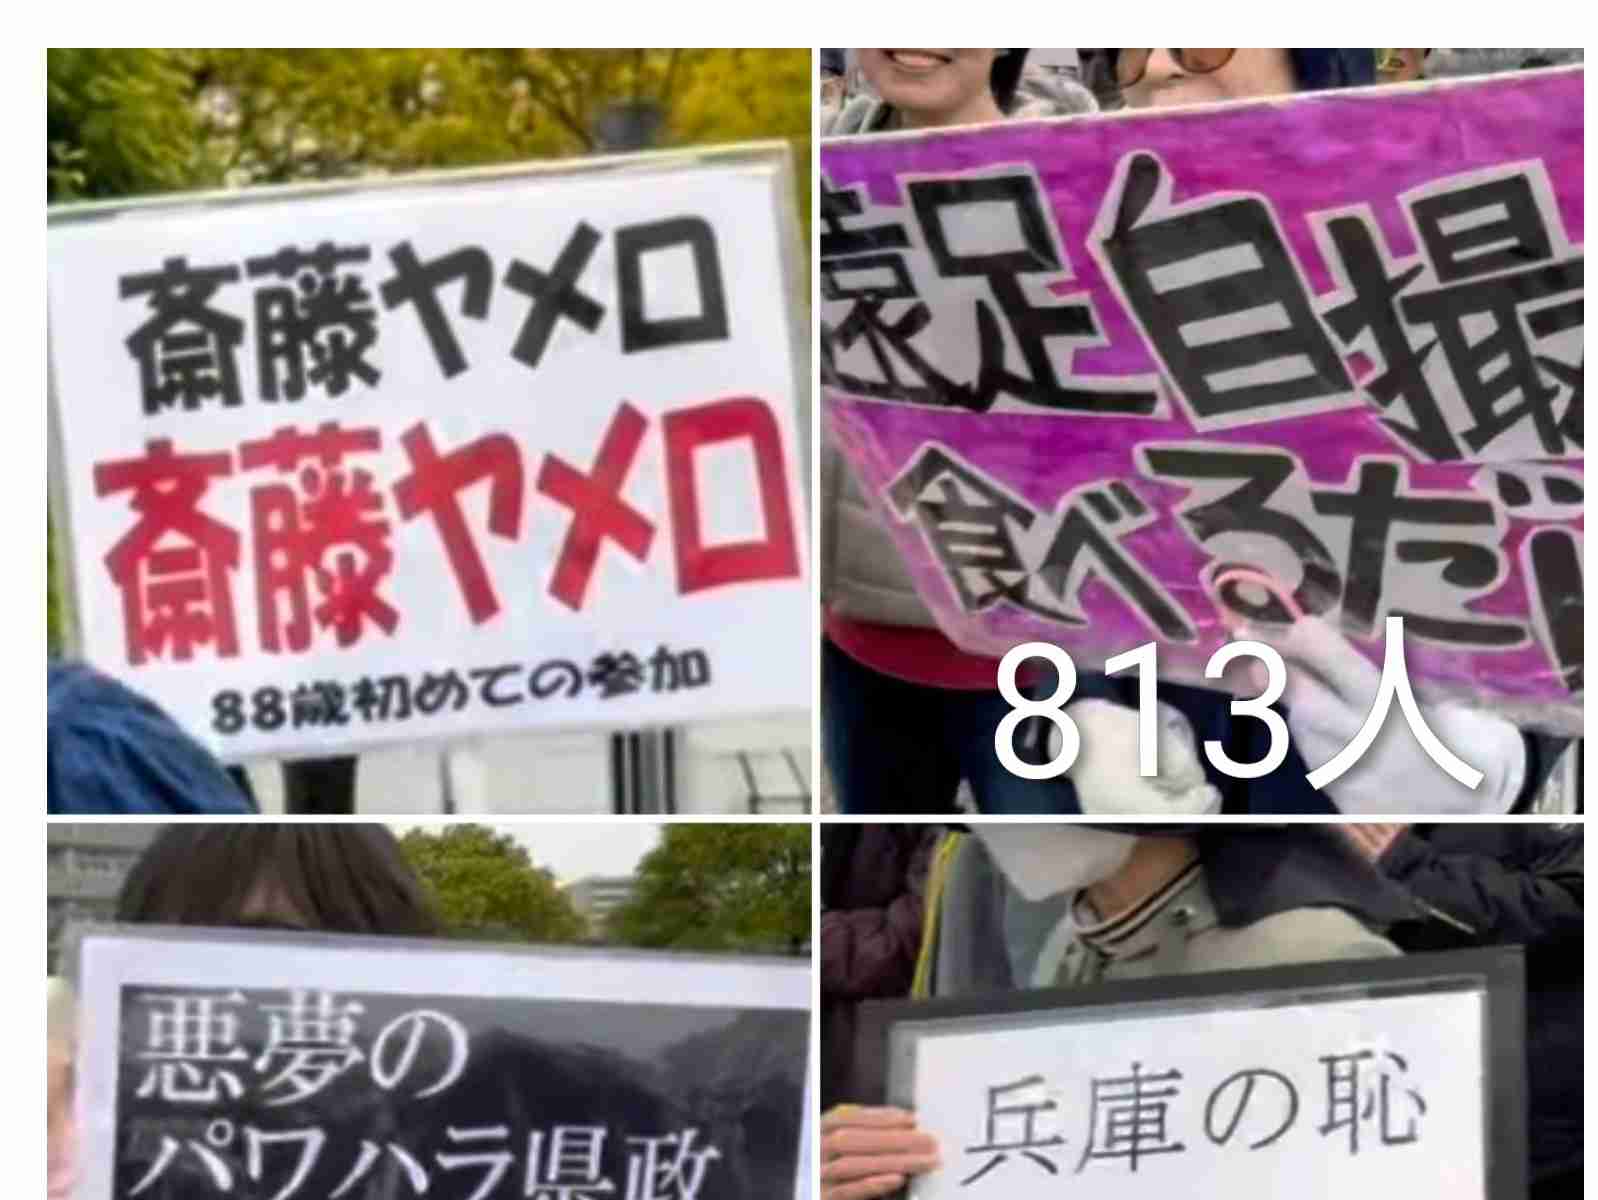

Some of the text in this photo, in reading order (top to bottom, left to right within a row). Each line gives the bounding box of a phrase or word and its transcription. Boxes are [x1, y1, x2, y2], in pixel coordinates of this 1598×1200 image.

[118, 215, 730, 415] 斎藤ヤメロ
[92, 395, 802, 666] 斎藤ヤメロ
[889, 444, 1584, 691] 食べるだ
[209, 644, 712, 735] 88歳初めての参加
[134, 989, 471, 1106] 悪夢の
[960, 1048, 1427, 1187] 兵庫の恥
